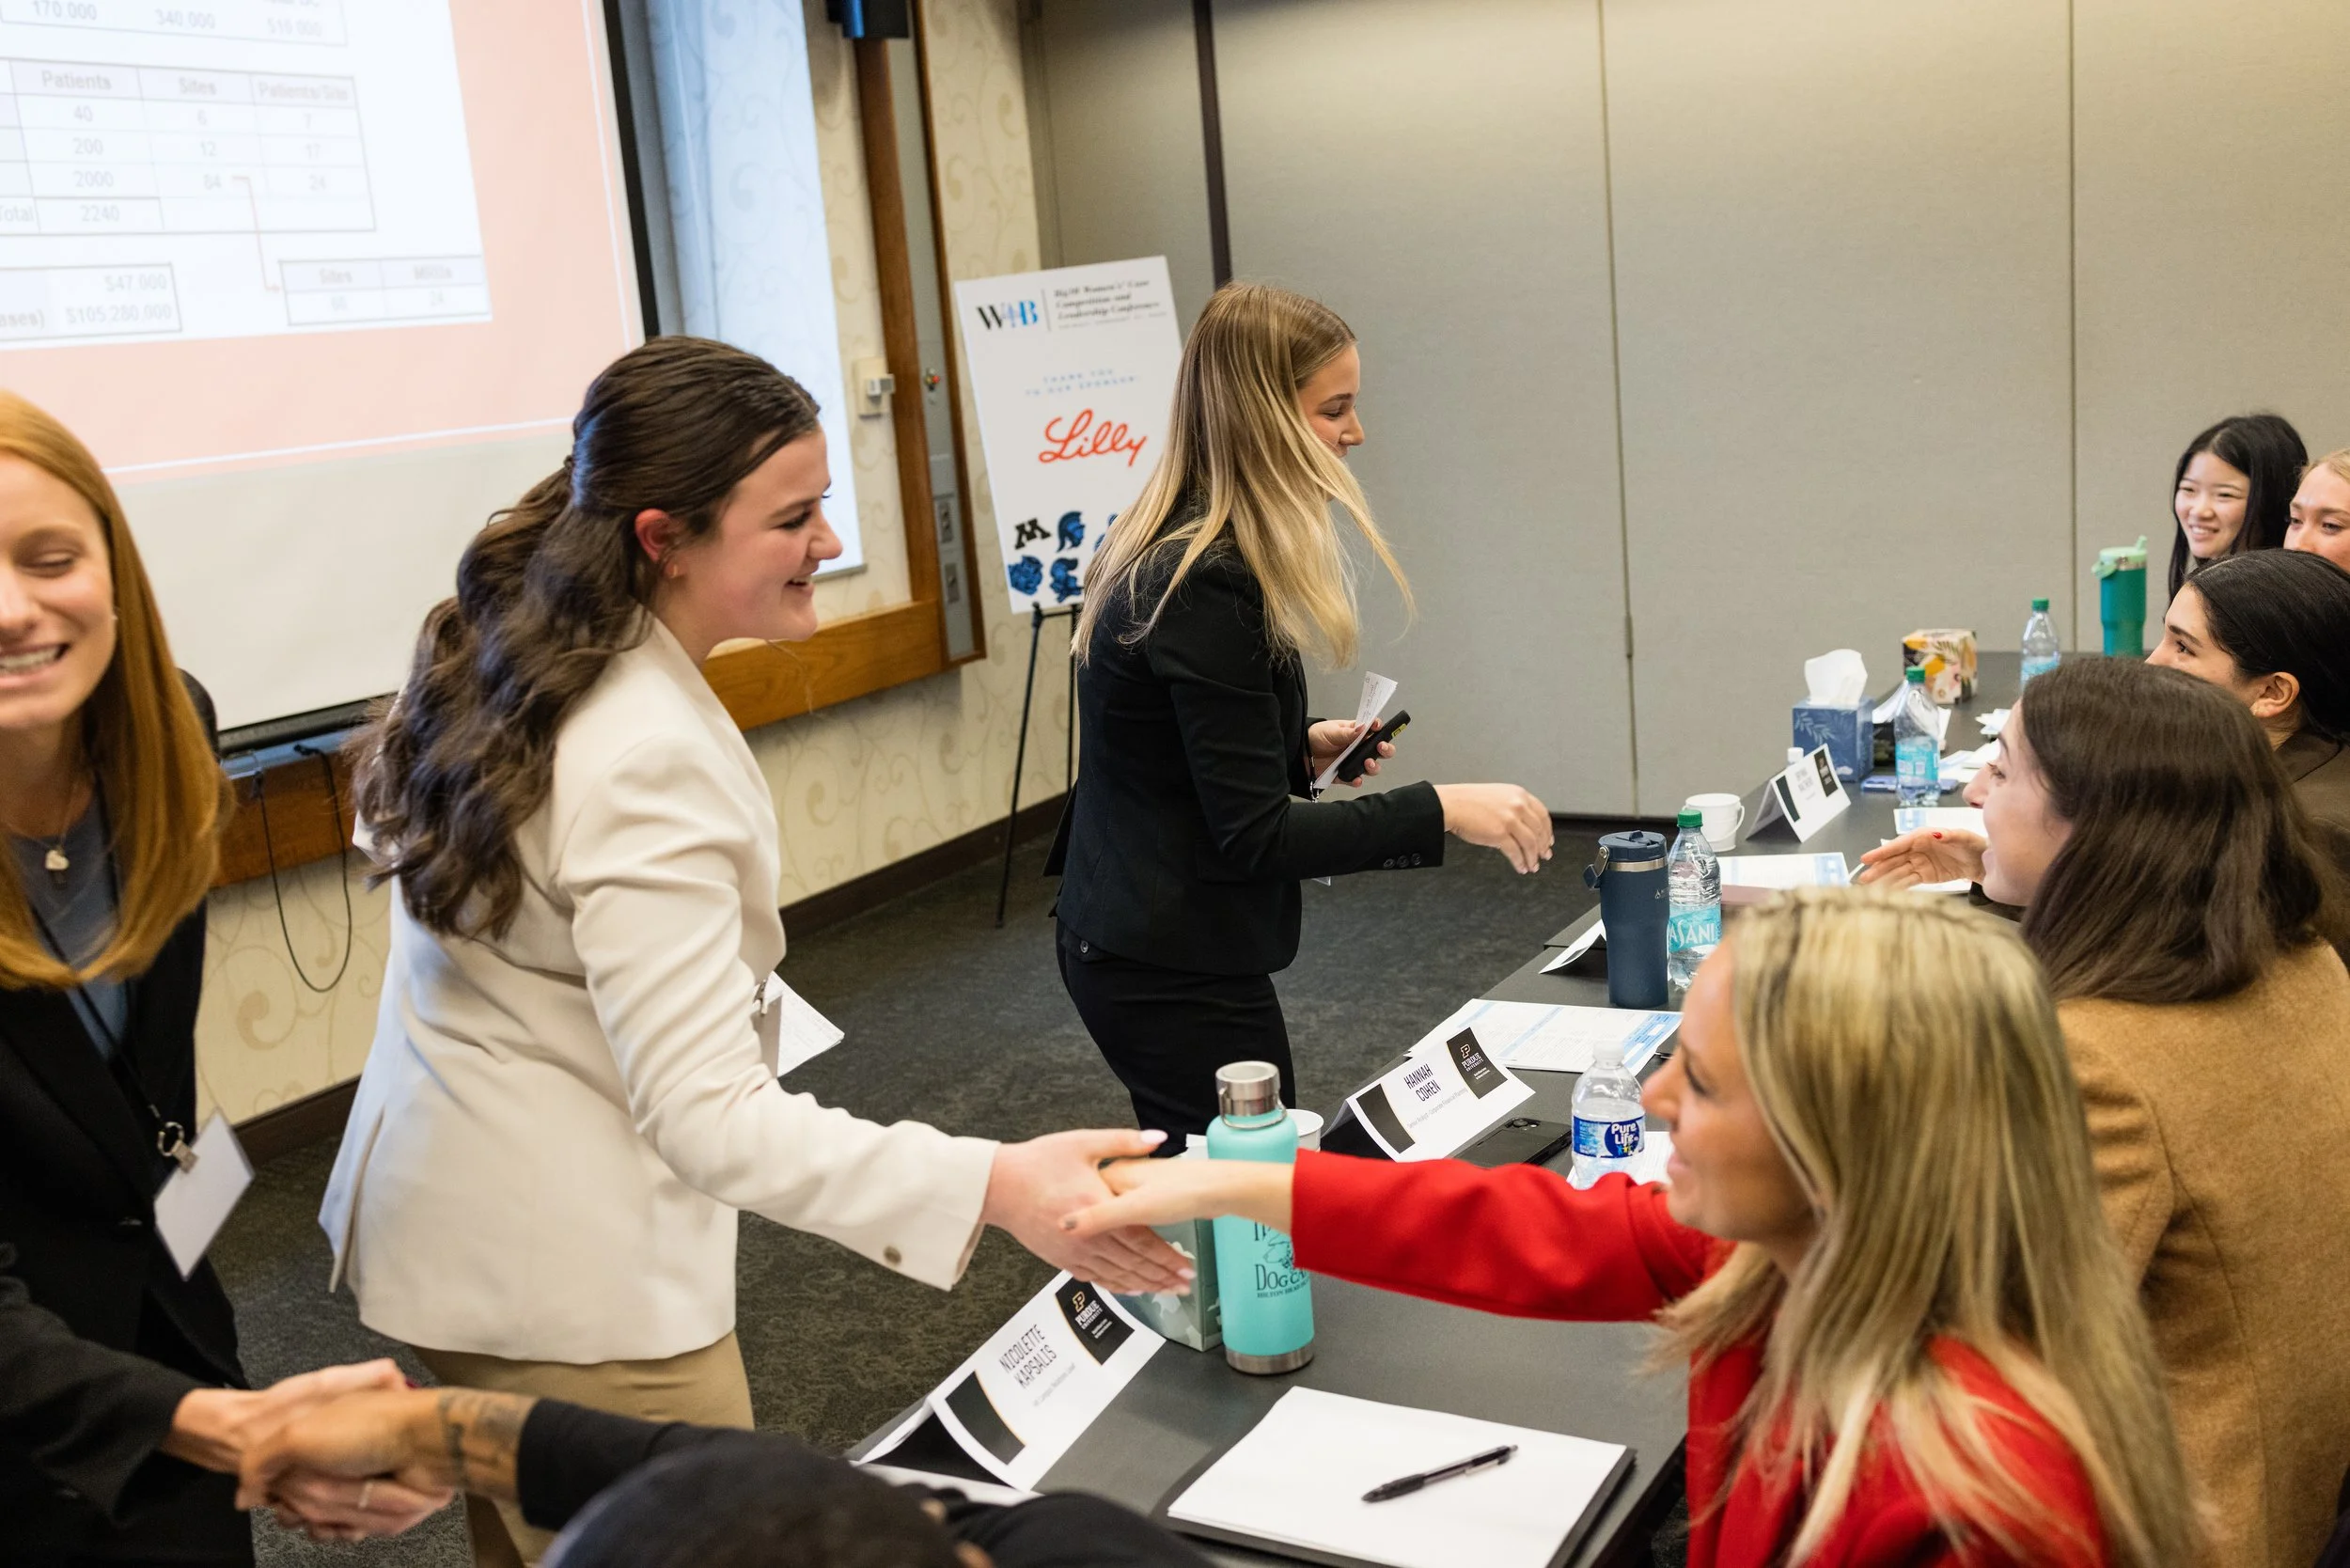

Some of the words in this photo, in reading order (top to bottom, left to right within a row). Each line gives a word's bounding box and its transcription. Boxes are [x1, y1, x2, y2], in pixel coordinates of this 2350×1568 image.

[40, 70, 113, 91] Patients
[178, 77, 217, 95] Sites
[73, 105, 93, 122] 40
[72, 137, 103, 156] 200
[199, 140, 217, 157] 12
[72, 170, 115, 188] 2000
[0, 204, 35, 222] otal
[79, 205, 120, 222] 2240
[1039, 408, 1147, 467] Lilly
[1668, 919, 1715, 948] ASANI
[1461, 1052, 1482, 1069] PURDUE
[1403, 1063, 1434, 1090] HANNAH
[1416, 1079, 1441, 1102] COHEN
[1611, 1122, 1637, 1135] Pure
[1615, 1133, 1634, 1146] Life
[1074, 1299, 1100, 1325] PURDUE
[999, 1324, 1045, 1373] NICOLETTE
[1013, 1344, 1057, 1389] KAPSALIS
